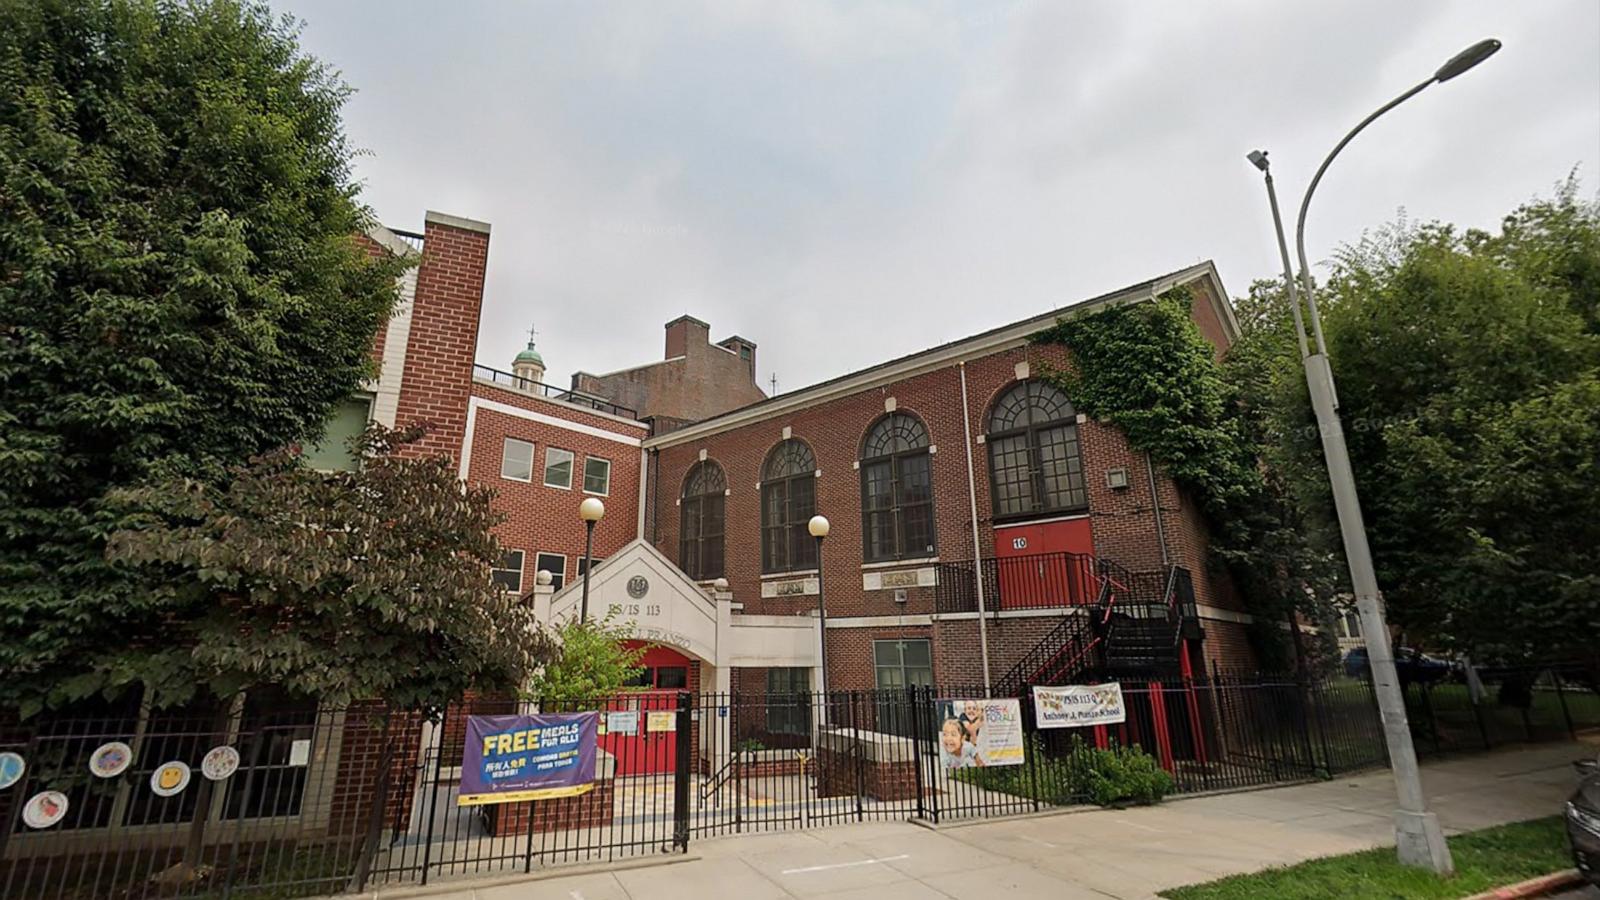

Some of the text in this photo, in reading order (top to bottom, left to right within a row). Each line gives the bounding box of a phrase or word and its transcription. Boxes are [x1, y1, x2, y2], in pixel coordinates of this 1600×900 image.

[1015, 538, 1026, 548] 10
[646, 605, 661, 616] 113
[1080, 694, 1091, 704] 113
[1043, 711, 1069, 722] Anthony
[1099, 707, 1120, 717] School
[483, 723, 579, 757] FREE MEALS
[541, 733, 579, 748] FOR ALL!
